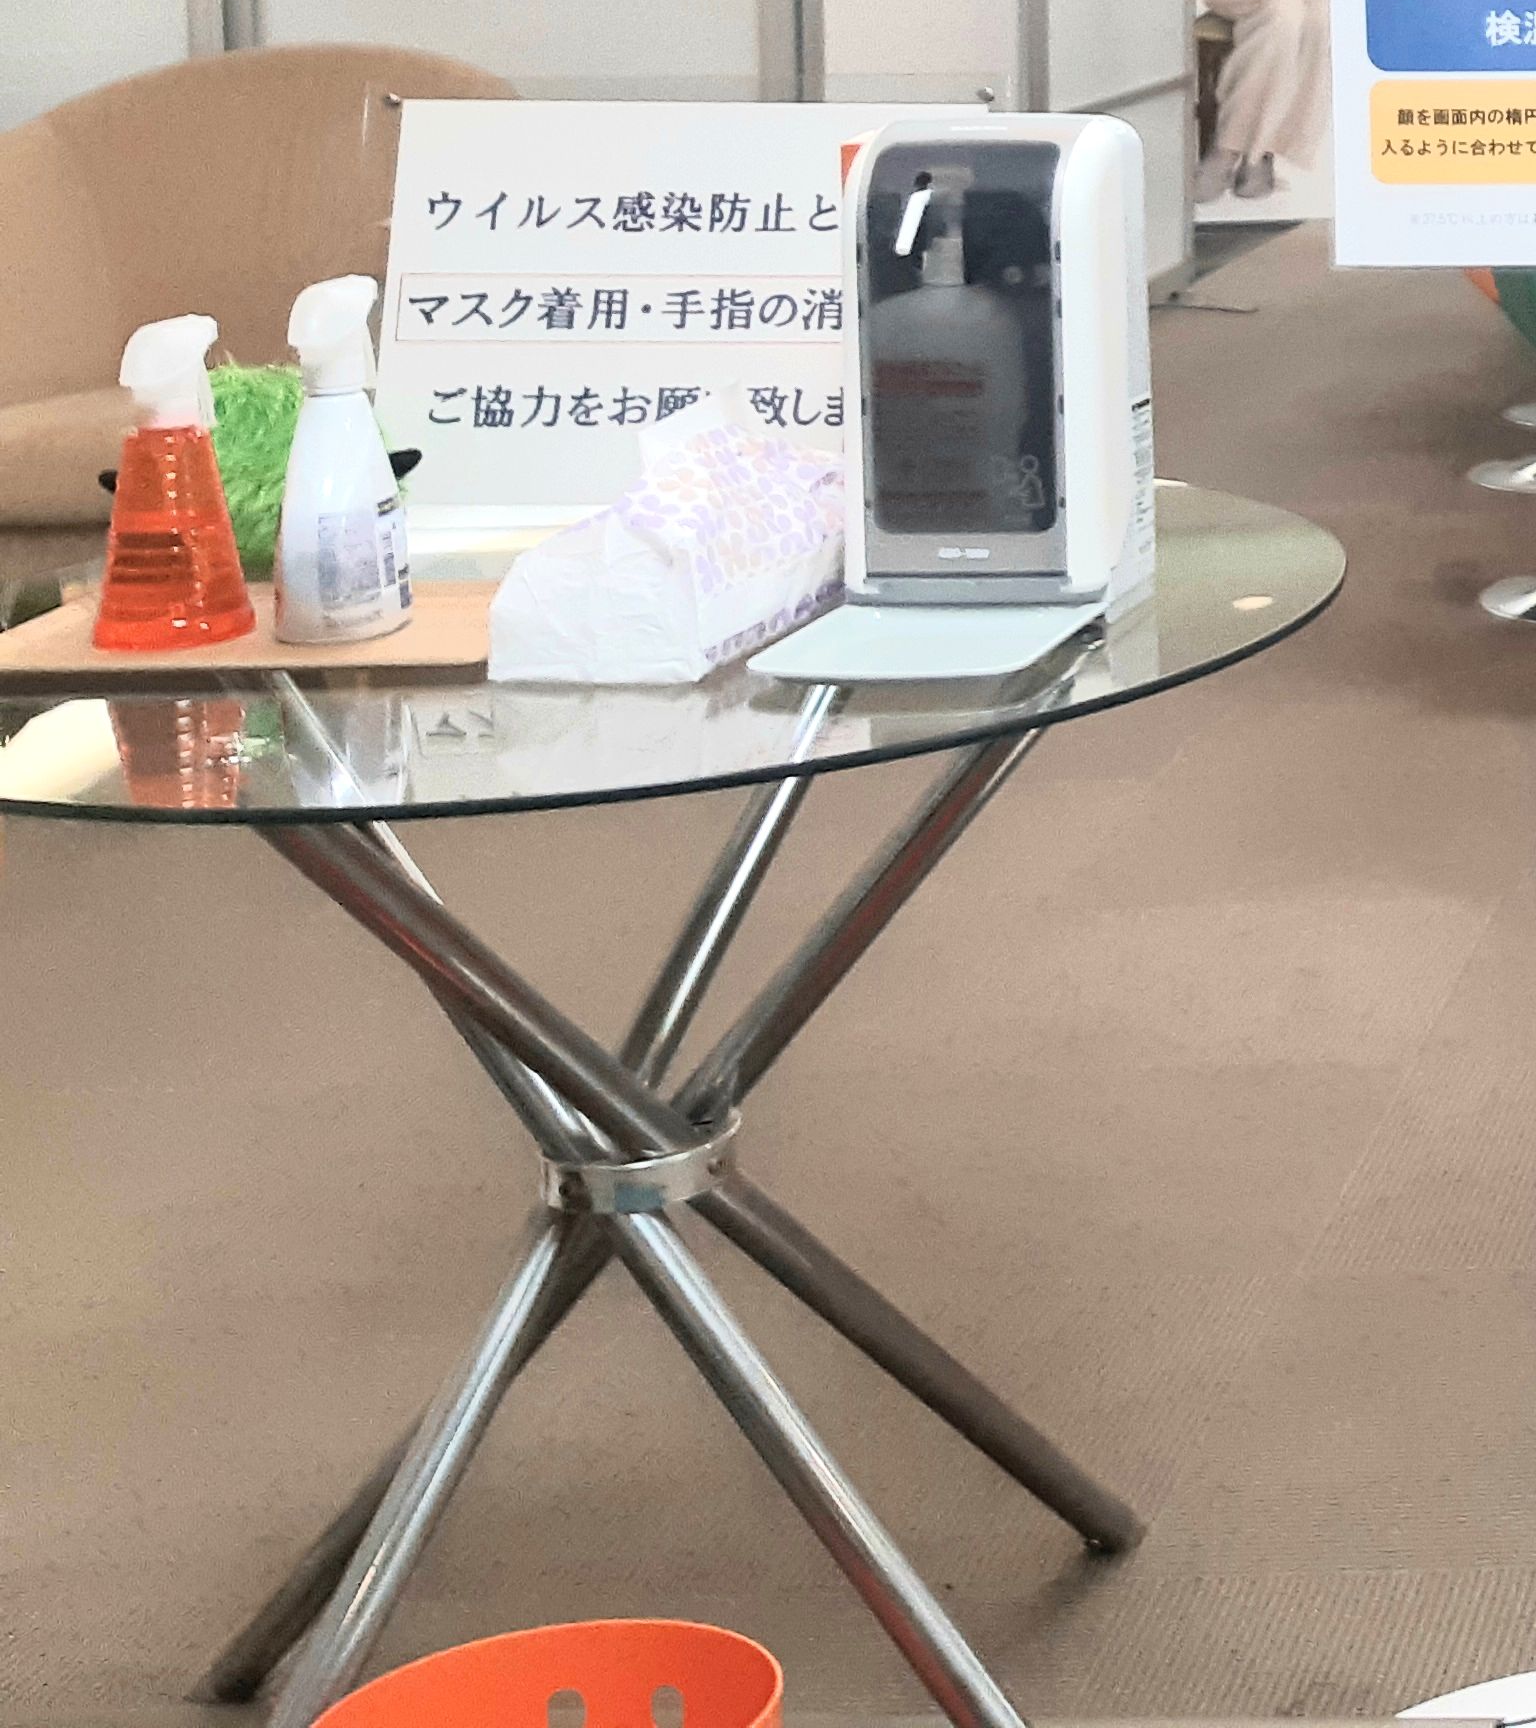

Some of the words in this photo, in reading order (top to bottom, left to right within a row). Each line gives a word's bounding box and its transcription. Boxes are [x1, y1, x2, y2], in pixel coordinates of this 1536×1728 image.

[427, 190, 842, 235] ウイルス感染防止と
[408, 285, 843, 331] マスク着用・手指の消
[429, 383, 844, 429] ご協力をお願致しま
